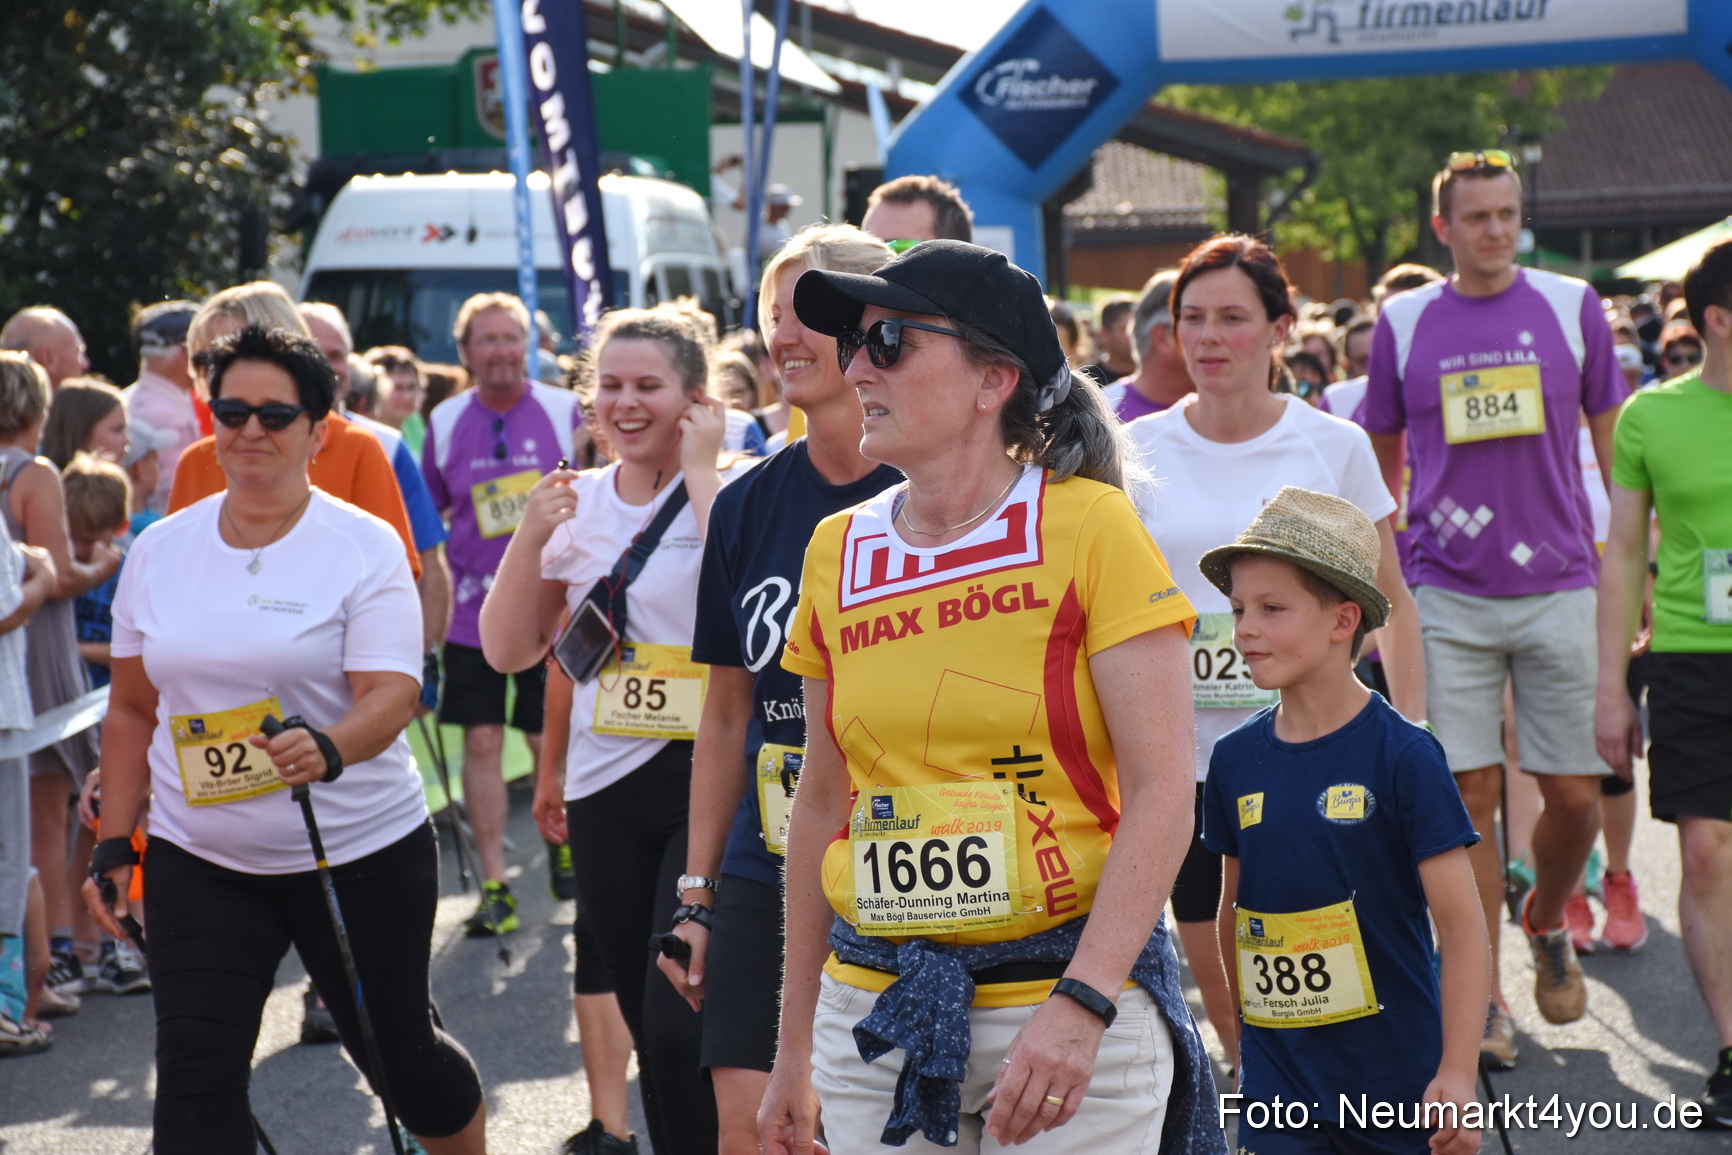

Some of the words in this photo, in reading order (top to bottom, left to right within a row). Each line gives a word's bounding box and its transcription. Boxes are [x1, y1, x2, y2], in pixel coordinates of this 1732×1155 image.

[1465, 391, 1519, 420] 884
[839, 606, 924, 655] MAX
[937, 581, 1050, 629] BÖGL
[623, 677, 667, 711] 85
[611, 710, 641, 720] Fischer
[644, 712, 681, 723] Melanie
[204, 742, 252, 778] 92
[244, 768, 273, 782] Sigrid
[1330, 794, 1362, 812] Burgis
[864, 814, 921, 831] firmenlauf
[931, 818, 963, 836] walk
[966, 820, 1002, 834] 2019
[863, 835, 992, 893] 1666
[856, 894, 953, 910] Schäfer-Dunning
[957, 891, 1010, 905] Martina
[870, 912, 884, 922] Max
[887, 911, 904, 923] Bögl
[907, 909, 957, 921] Bauservice
[960, 906, 991, 917] GmbH
[1293, 938, 1319, 953] walk
[1322, 934, 1351, 950] 2019
[1253, 952, 1332, 996] 388
[1263, 997, 1298, 1008] Fersch
[1301, 995, 1330, 1007] Julia
[1271, 1009, 1295, 1019] Burgis
[1297, 1007, 1322, 1017] GmbH
